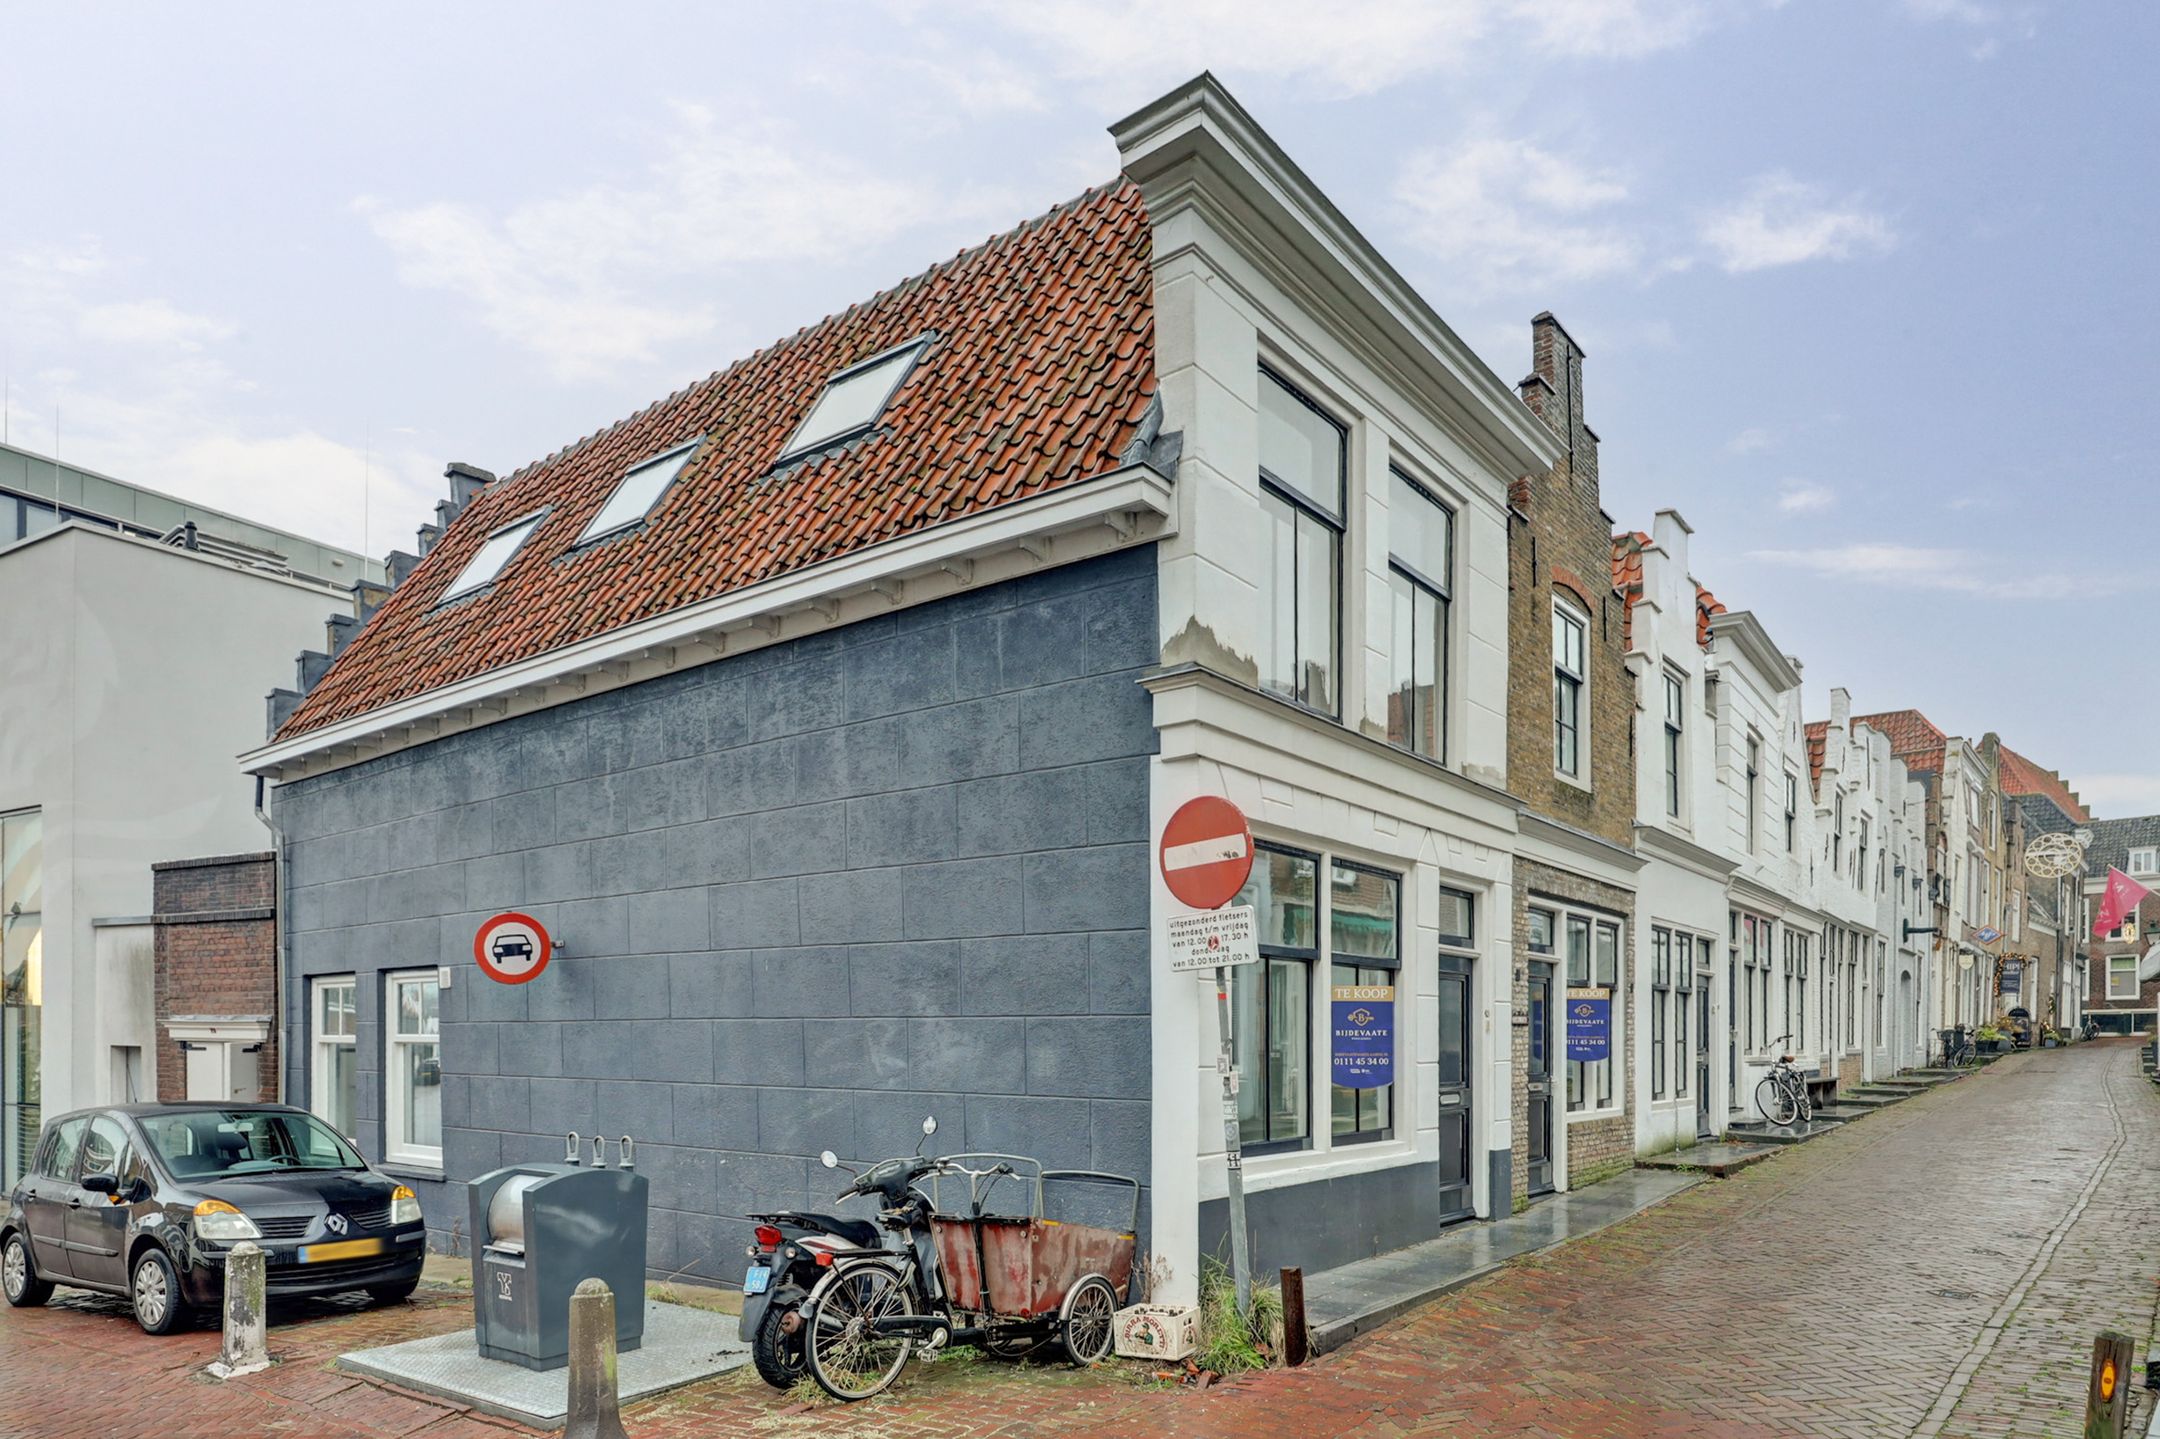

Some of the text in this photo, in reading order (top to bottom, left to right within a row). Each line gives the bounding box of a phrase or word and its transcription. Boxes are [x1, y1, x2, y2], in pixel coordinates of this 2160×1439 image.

[1170, 912, 1248, 929] uitgezonderd fietsers
[1171, 922, 1249, 938] maandag t/m vrijdag
[1187, 937, 1207, 945] 12.00
[1191, 946, 1230, 956] donddag
[1173, 960, 1186, 968] van
[1187, 958, 1207, 966] 12.00
[1222, 954, 1243, 962] 21.00
[1334, 988, 1388, 999] TE KOOP
[1580, 989, 1605, 998] KOOP
[1335, 1029, 1388, 1037] BIJDEVAATE
[1334, 1057, 1389, 1065] 0111 45 34 00
